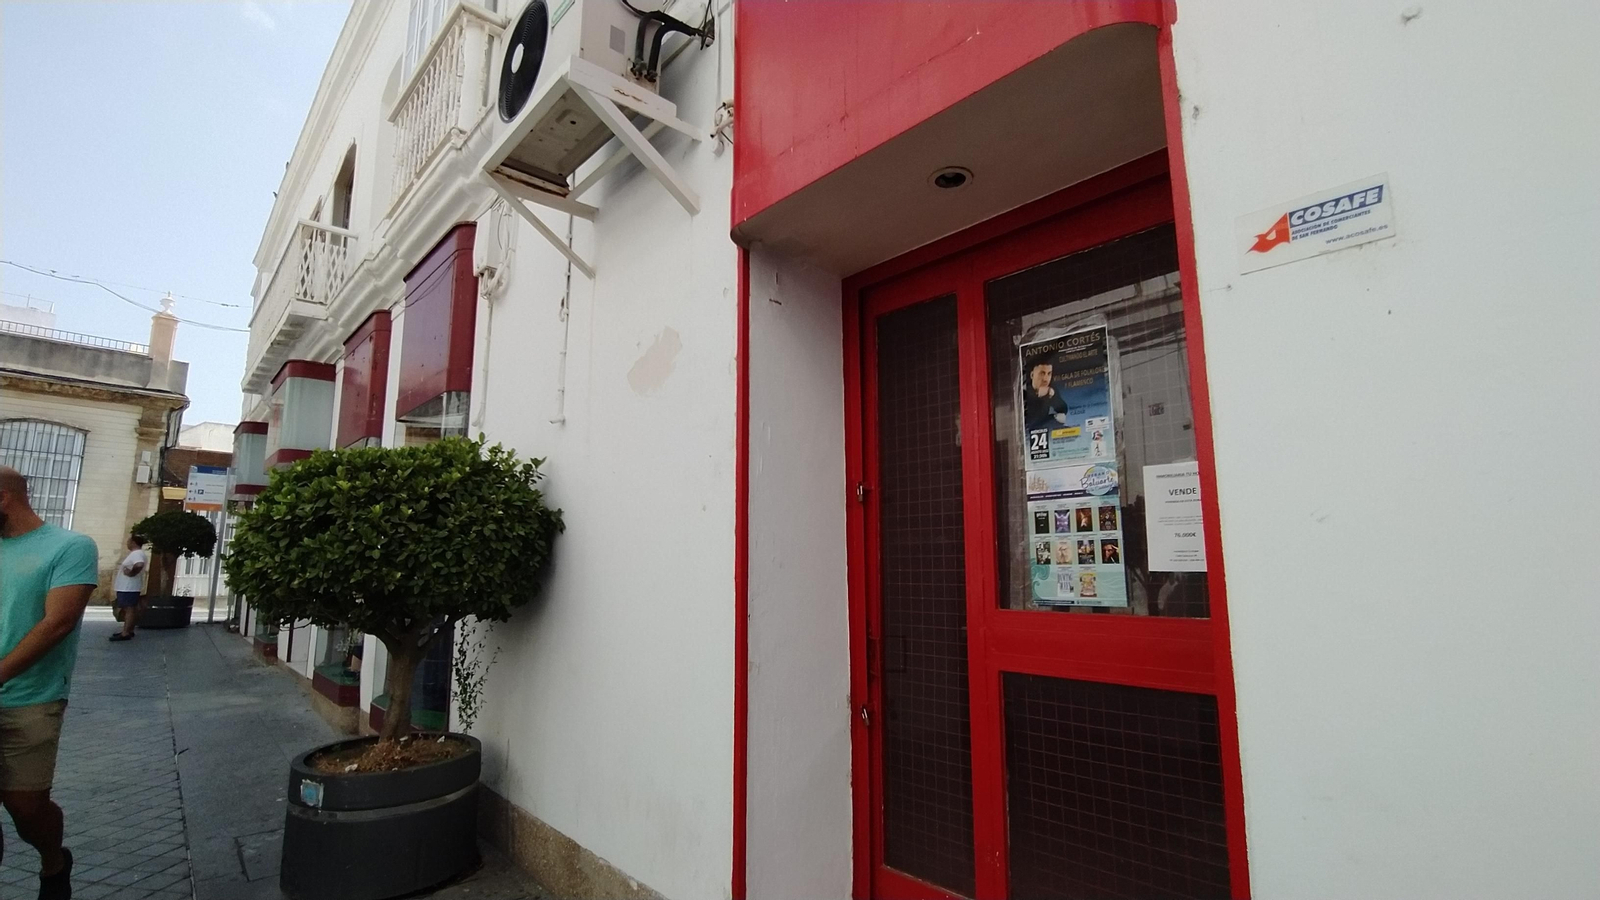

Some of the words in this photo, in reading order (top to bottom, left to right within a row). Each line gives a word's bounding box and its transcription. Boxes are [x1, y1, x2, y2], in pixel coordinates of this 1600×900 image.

[1331, 210, 1371, 225] COMERCIANTES
[1310, 224, 1338, 237] FERNANDO
[1326, 224, 1388, 244] www.acosafe.es
[1025, 341, 1065, 357] ANTONIO
[1066, 331, 1101, 347] CORTÉS
[1031, 433, 1048, 450] 24
[1168, 487, 1197, 496] VENDE
